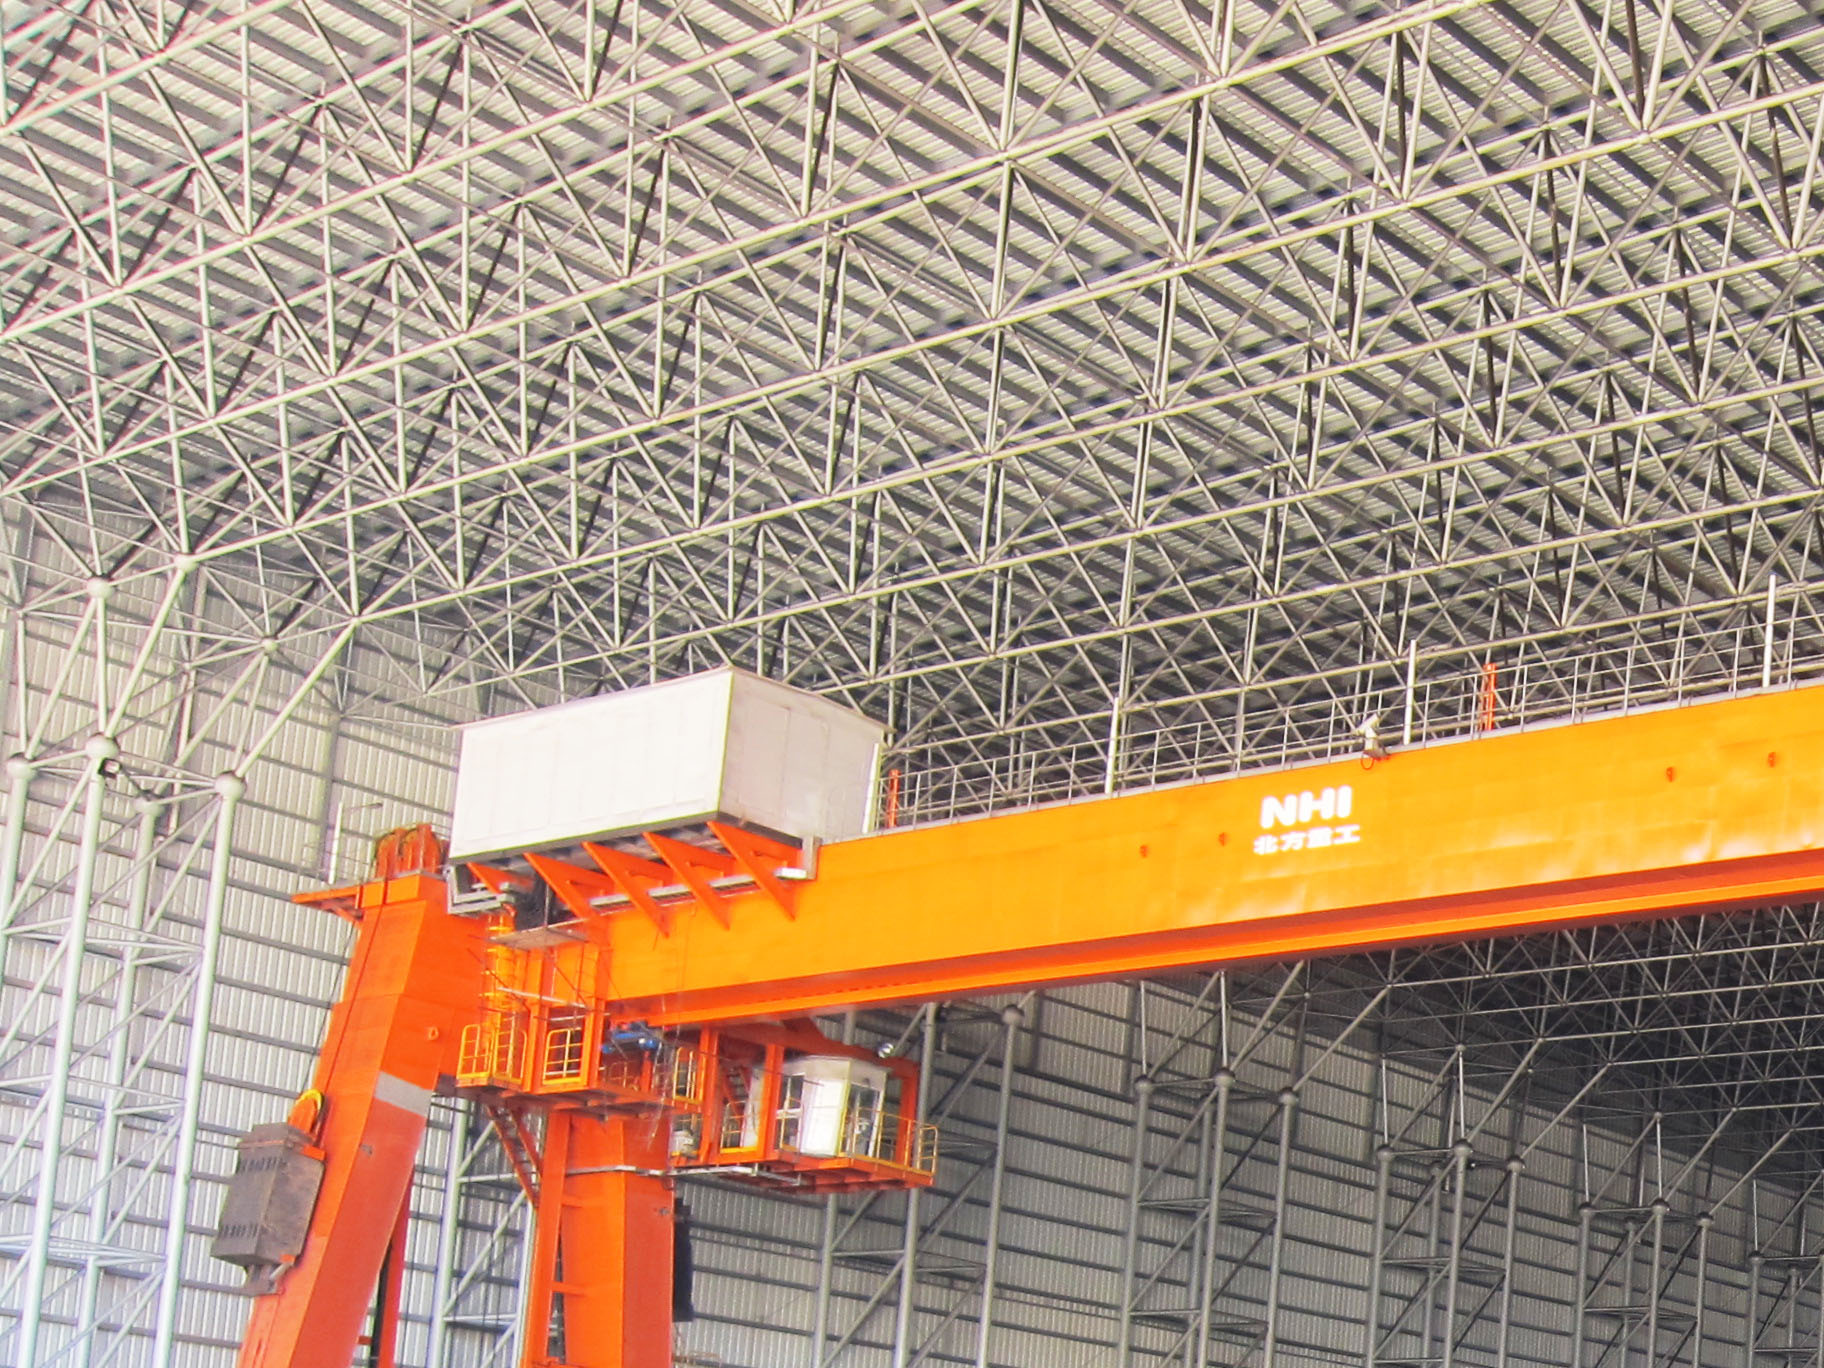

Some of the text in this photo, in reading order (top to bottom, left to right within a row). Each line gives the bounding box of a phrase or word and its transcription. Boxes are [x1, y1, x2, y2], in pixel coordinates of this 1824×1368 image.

[1260, 785, 1353, 829] NHI
[1254, 824, 1361, 855] 北方重工
